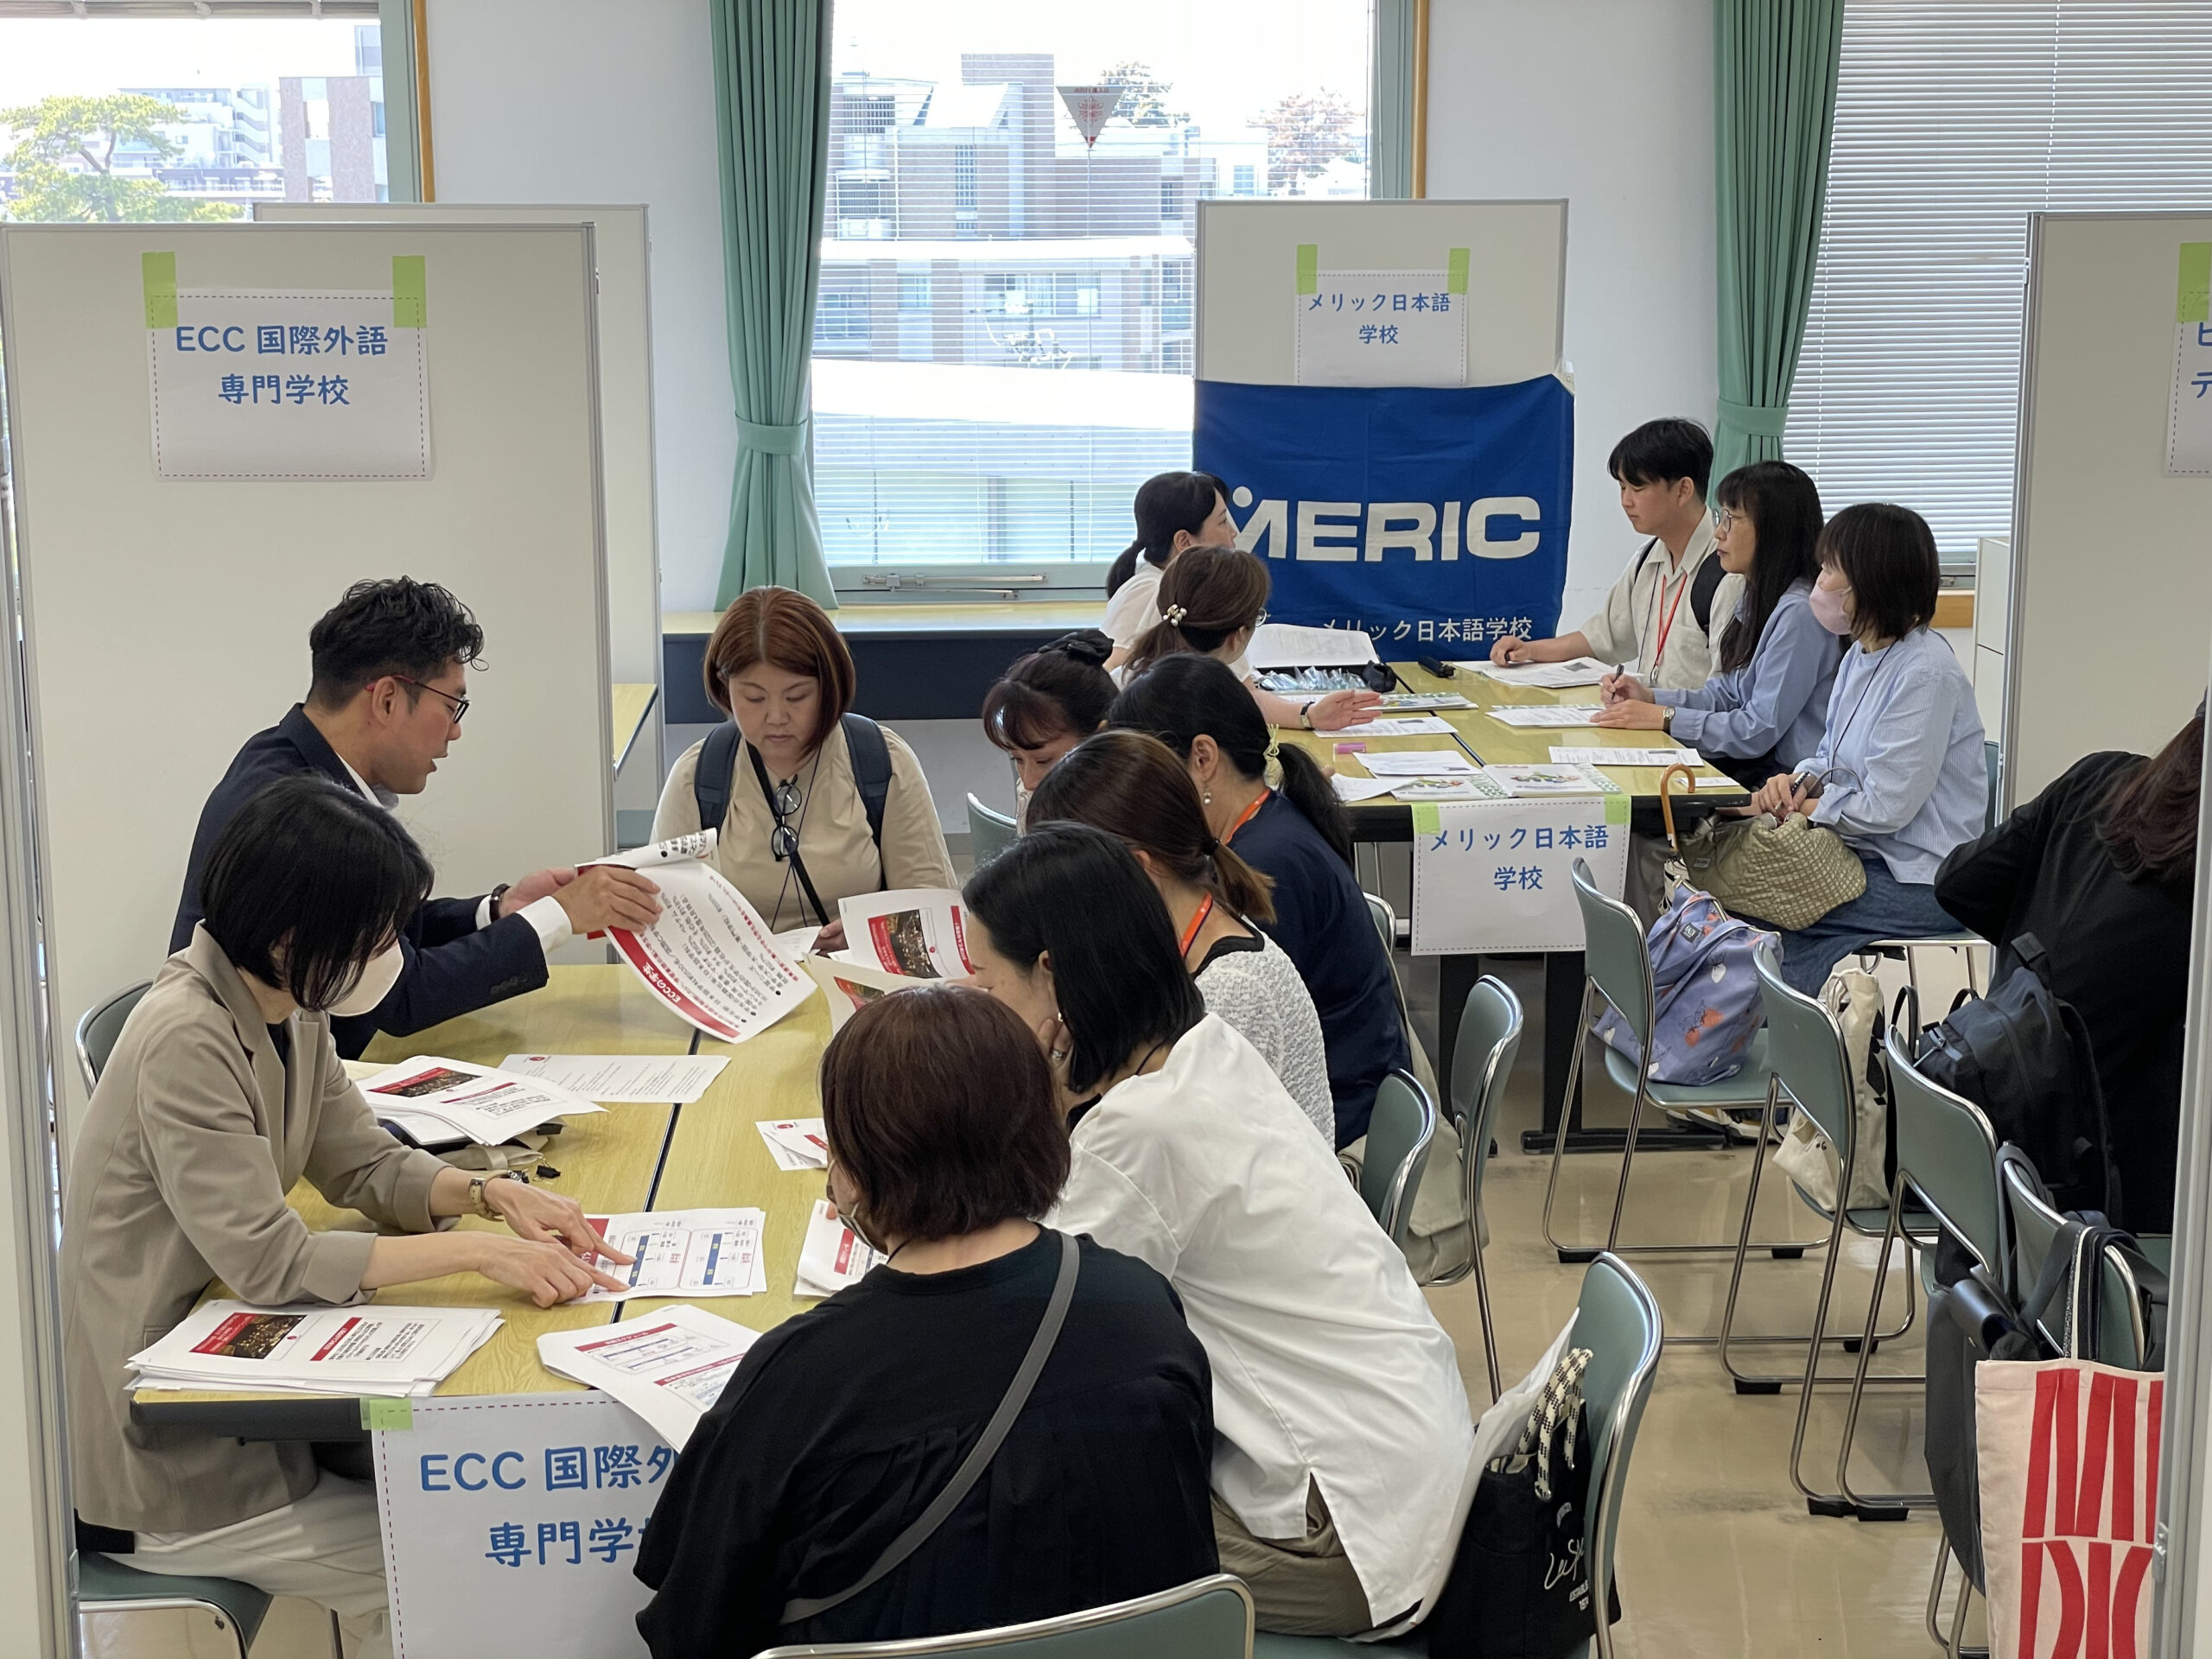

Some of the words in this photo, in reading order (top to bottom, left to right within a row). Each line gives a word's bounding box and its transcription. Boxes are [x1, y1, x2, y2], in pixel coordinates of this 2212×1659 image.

[1307, 292, 1451, 313] メリック日本語
[175, 326, 245, 353] ECC
[257, 325, 388, 355] 国際外語
[1358, 324, 1399, 345] 学校
[218, 373, 351, 406] 専門学校
[1232, 486, 1541, 562] MERIC
[1431, 823, 1610, 852] メリック日本語
[1493, 866, 1543, 892] 学校
[642, 961, 682, 1003] ECCの学生
[421, 1451, 526, 1491] ECC
[544, 1444, 680, 1492] 国際外
[486, 1517, 651, 1567] 専門学
